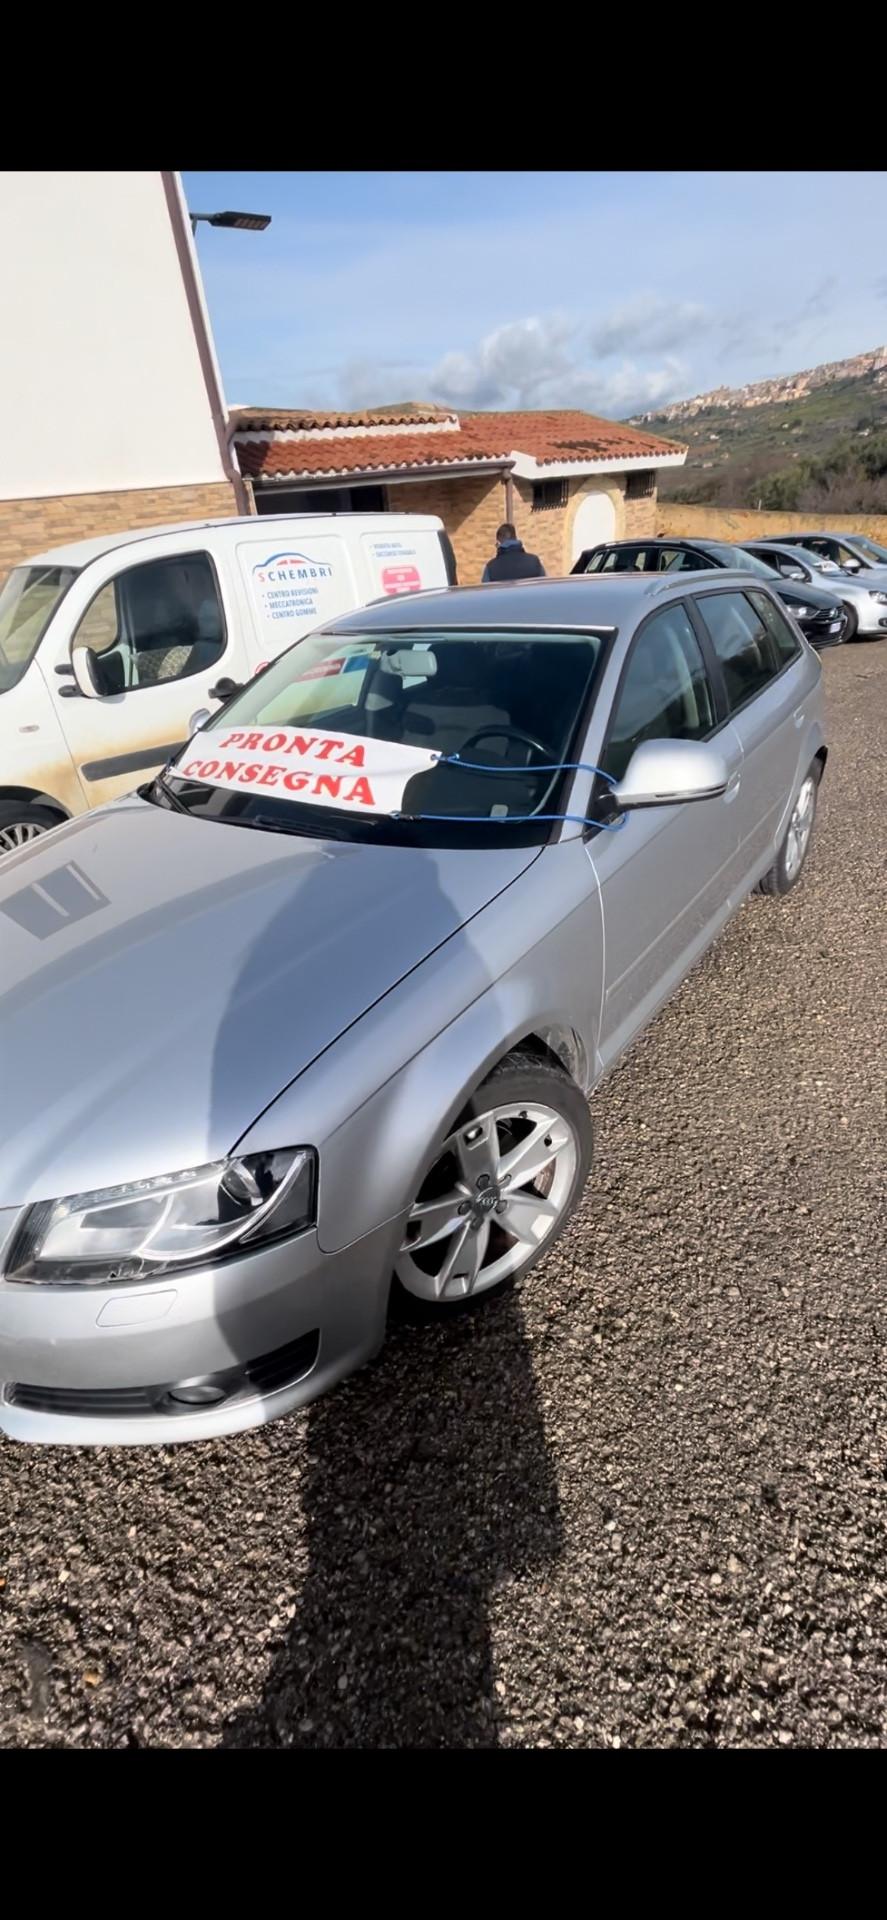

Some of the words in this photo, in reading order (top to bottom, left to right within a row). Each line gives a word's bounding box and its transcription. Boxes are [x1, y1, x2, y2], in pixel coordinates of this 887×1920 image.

[257, 567, 332, 582] SCHEMBRI
[266, 590, 290, 599] CENTRO
[269, 598, 313, 609] MECCATRONICA
[272, 610, 295, 619] CENTRO
[295, 607, 317, 617] GOMME
[219, 733, 365, 767] PRONTA
[183, 760, 376, 805] CONSEGNA
